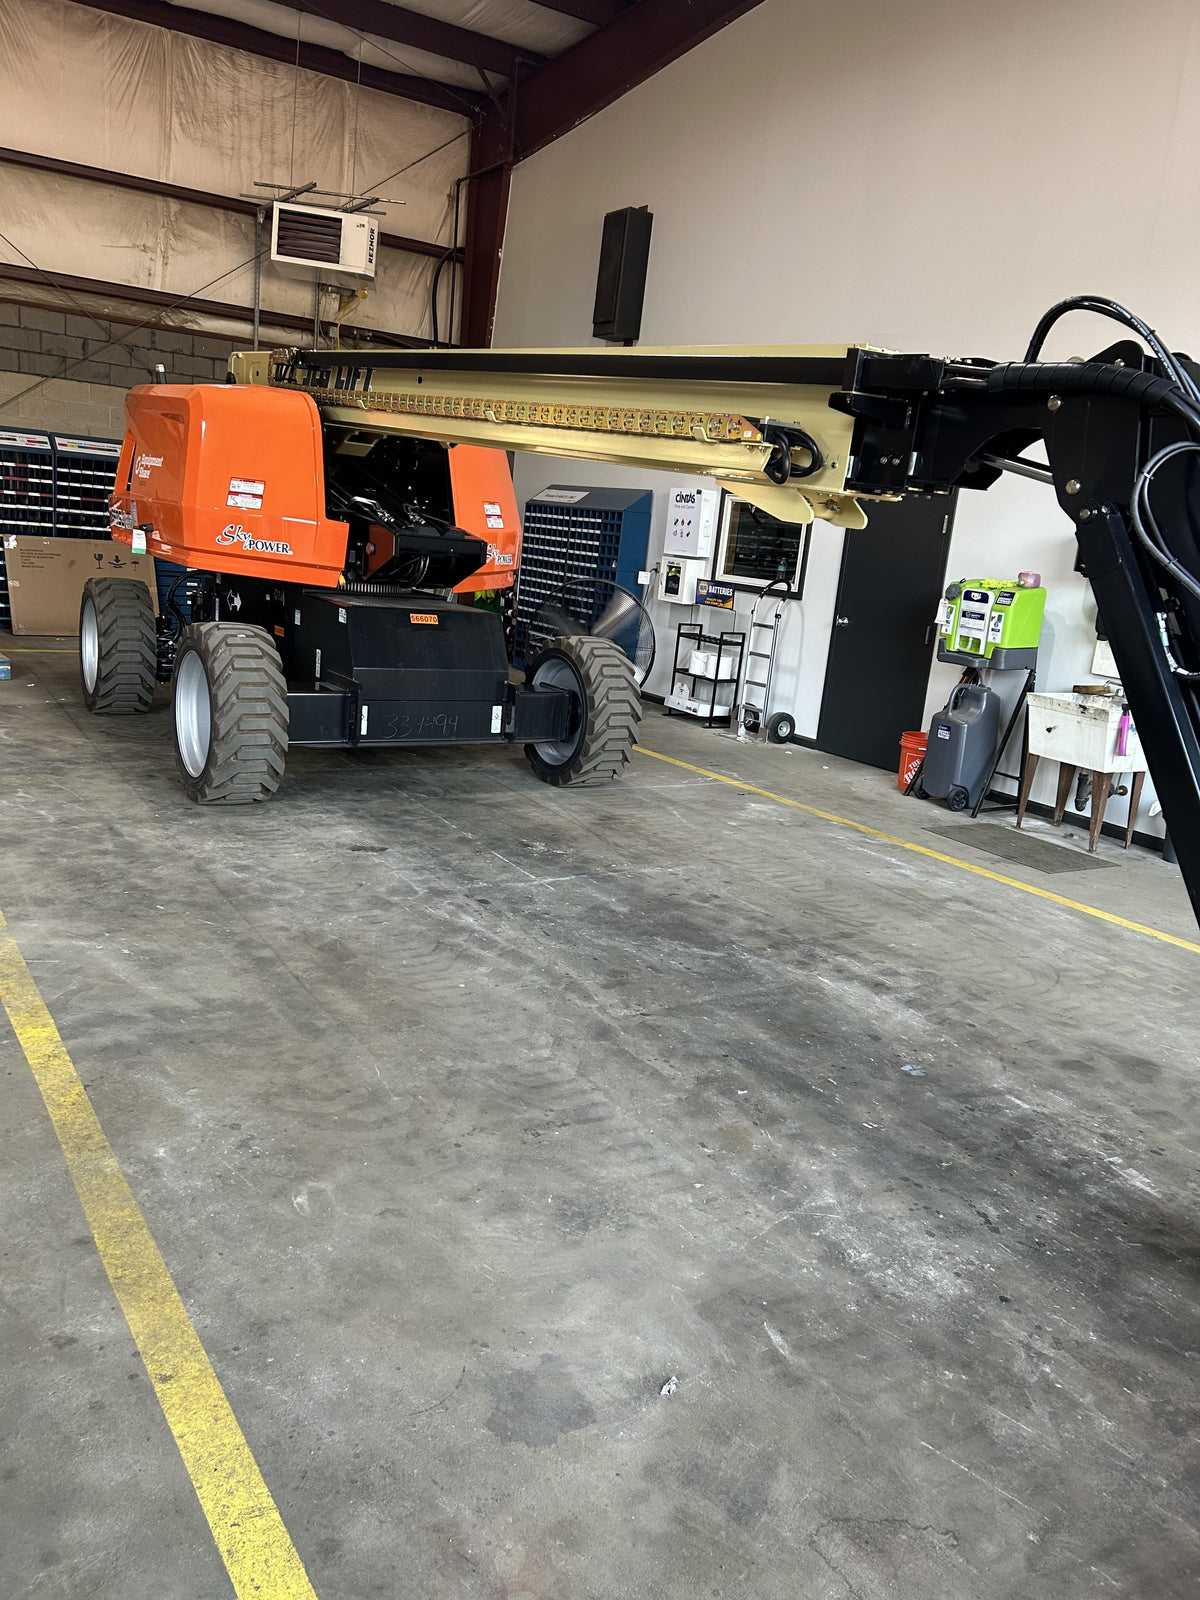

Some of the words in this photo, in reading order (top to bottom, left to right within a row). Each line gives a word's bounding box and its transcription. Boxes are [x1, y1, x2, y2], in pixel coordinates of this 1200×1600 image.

[368, 227, 376, 264] REZNOR
[216, 523, 252, 550] Sky
[248, 539, 290, 555] POWER
[708, 585, 734, 597] BATTERIES
[411, 614, 438, 623] 566070
